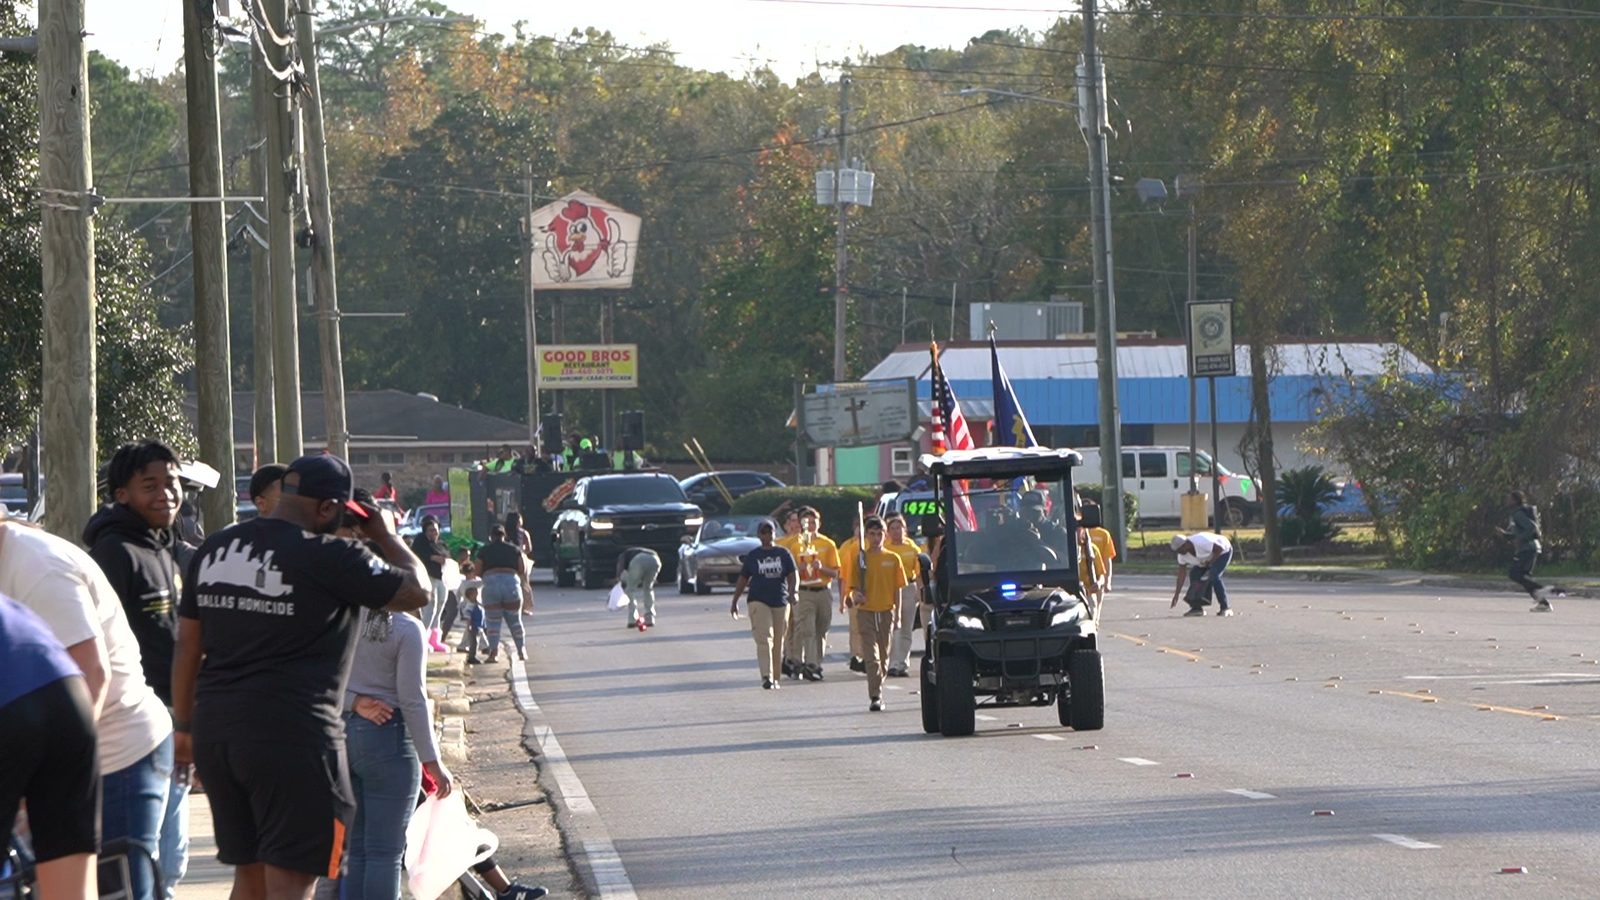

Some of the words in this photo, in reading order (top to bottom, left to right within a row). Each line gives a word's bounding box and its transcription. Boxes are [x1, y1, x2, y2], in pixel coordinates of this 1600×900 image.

[543, 351, 586, 362] GOOD
[592, 350, 630, 361] BROS
[197, 594, 235, 609] DALLAS
[237, 597, 295, 616] HOMICIDE
